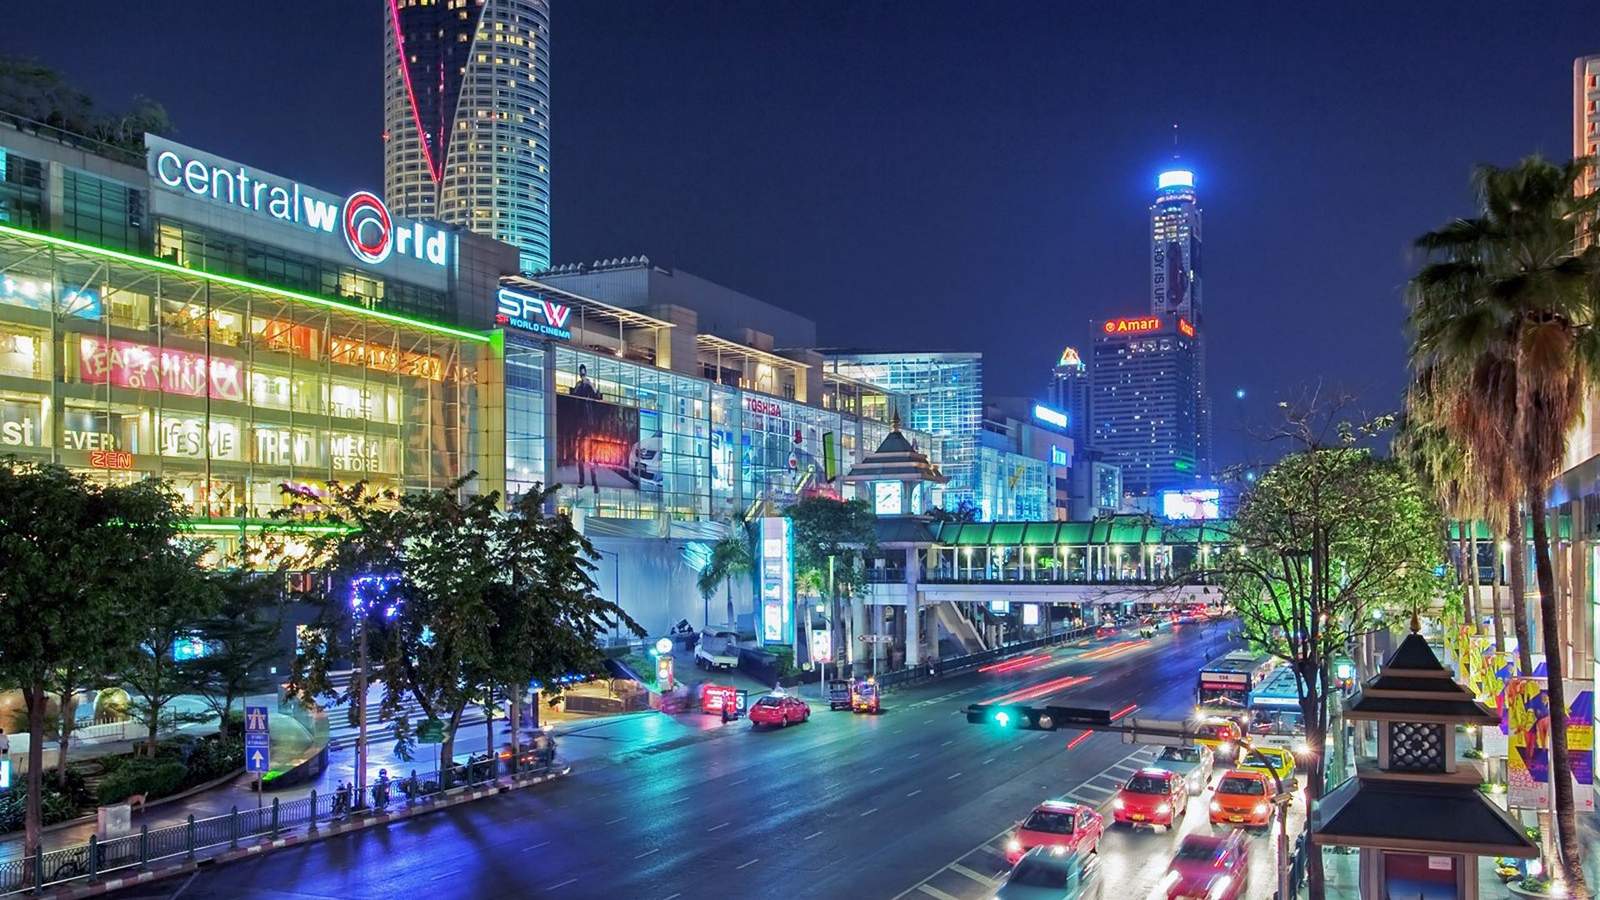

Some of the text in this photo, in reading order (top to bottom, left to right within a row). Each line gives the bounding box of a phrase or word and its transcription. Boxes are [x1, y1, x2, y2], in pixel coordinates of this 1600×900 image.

[509, 317, 539, 333] WORLD
[540, 323, 571, 340] CINEMA
[1117, 317, 1159, 332] Amari
[746, 397, 781, 417] TOSHIBA
[330, 434, 378, 459] MEGA
[92, 451, 132, 468] ZEN
[333, 457, 378, 472] STORE
